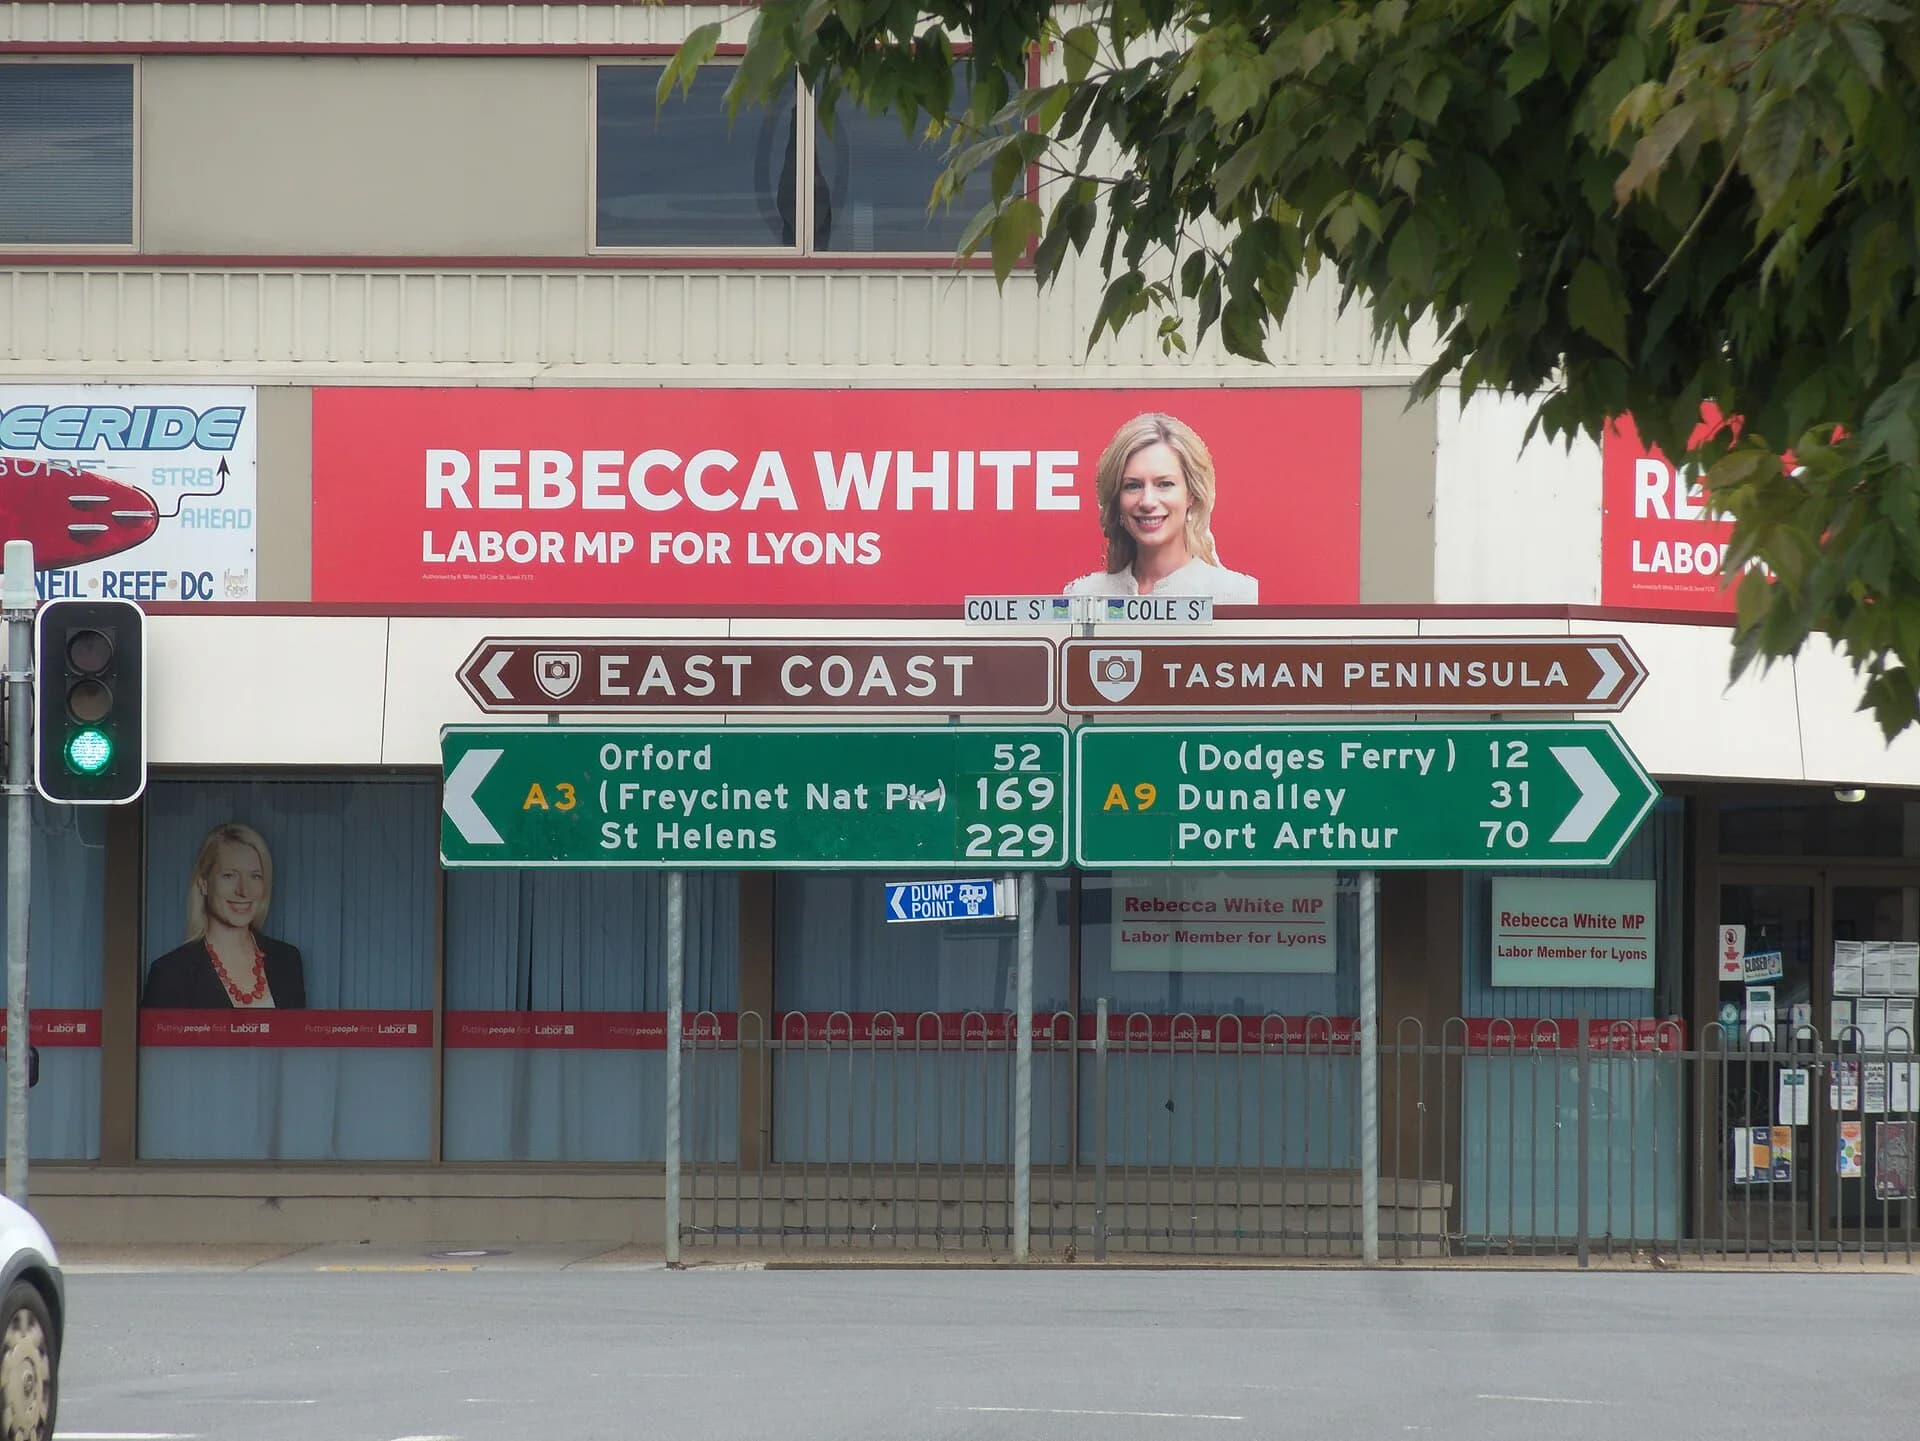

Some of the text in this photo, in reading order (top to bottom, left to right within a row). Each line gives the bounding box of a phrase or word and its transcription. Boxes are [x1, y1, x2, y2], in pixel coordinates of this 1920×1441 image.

[0, 405, 246, 451] EERIDE
[152, 468, 214, 486] STR8
[426, 449, 1081, 511] REBECCA WHITE
[180, 508, 251, 529] AHEAD
[423, 531, 881, 565] LABOR MP FOR LYONS
[102, 571, 167, 600] REEF
[180, 572, 213, 600] DC
[968, 600, 1017, 620] COLE
[1127, 600, 1176, 620] COLE
[600, 655, 973, 696] EAST COAST
[1163, 662, 1568, 688] TASMAN PENINSULA
[600, 743, 1041, 771] Orford 52
[1489, 741, 1528, 768] 12
[523, 783, 577, 811] A3
[807, 783, 868, 810] Nat
[977, 777, 1054, 811] 169
[1104, 783, 1157, 810] A9
[1179, 781, 1528, 816] Dunalley 31
[600, 822, 1054, 857] St Helens 229
[1179, 821, 1529, 849] Port Arthur 70
[911, 885, 953, 901] DUMP
[912, 901, 954, 918] POINT
[1125, 897, 1323, 914] Rebecca White MP
[1500, 912, 1645, 929] Rebecca White MP
[1121, 930, 1327, 947] Labor Member for Lyons
[1498, 945, 1647, 963] Labor Member for Lyons
[47, 1023, 75, 1033] Labor
[183, 1024, 211, 1033] people
[230, 1024, 259, 1033] Labor
[331, 1025, 359, 1034] people
[377, 1024, 407, 1034] Labor
[488, 1025, 516, 1035] people
[535, 1025, 564, 1035] Labor
[636, 1027, 664, 1036] people
[865, 1027, 894, 1036] Lbor
[1321, 1031, 1350, 1041] Lbor
